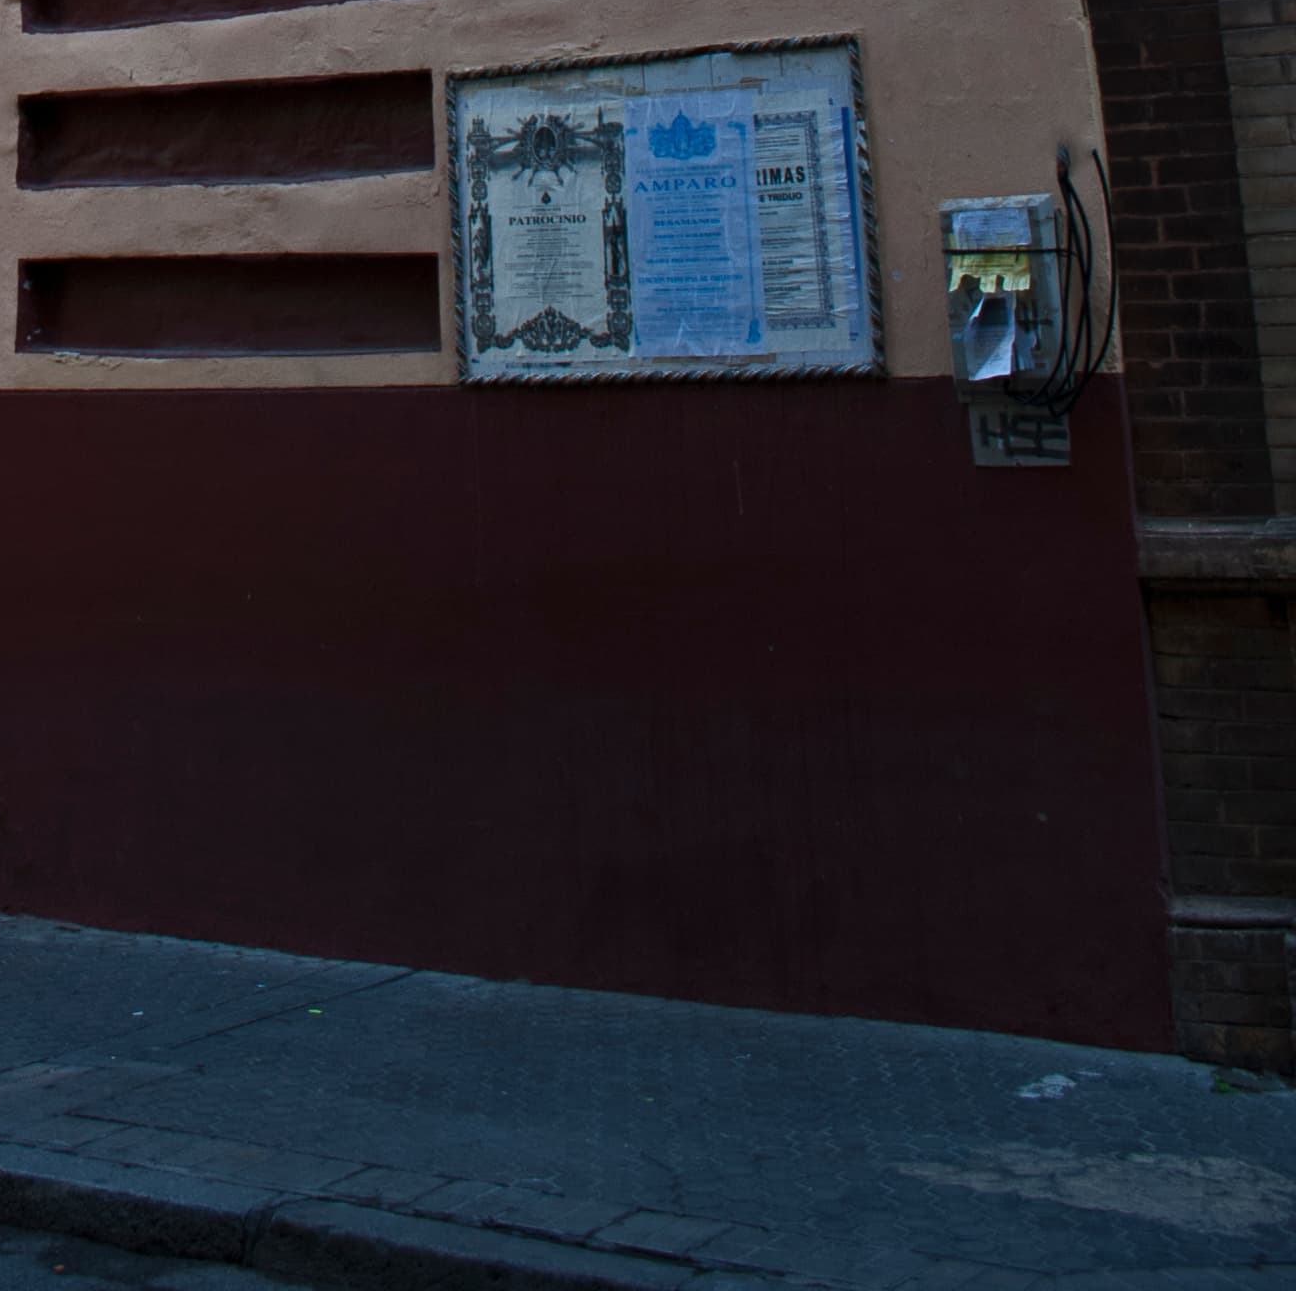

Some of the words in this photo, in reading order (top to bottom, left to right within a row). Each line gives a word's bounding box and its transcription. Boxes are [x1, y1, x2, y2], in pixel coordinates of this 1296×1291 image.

[634, 176, 736, 193] AMPARO
[767, 192, 803, 202] TRIDUO
[508, 214, 586, 226] PATROCINIO
